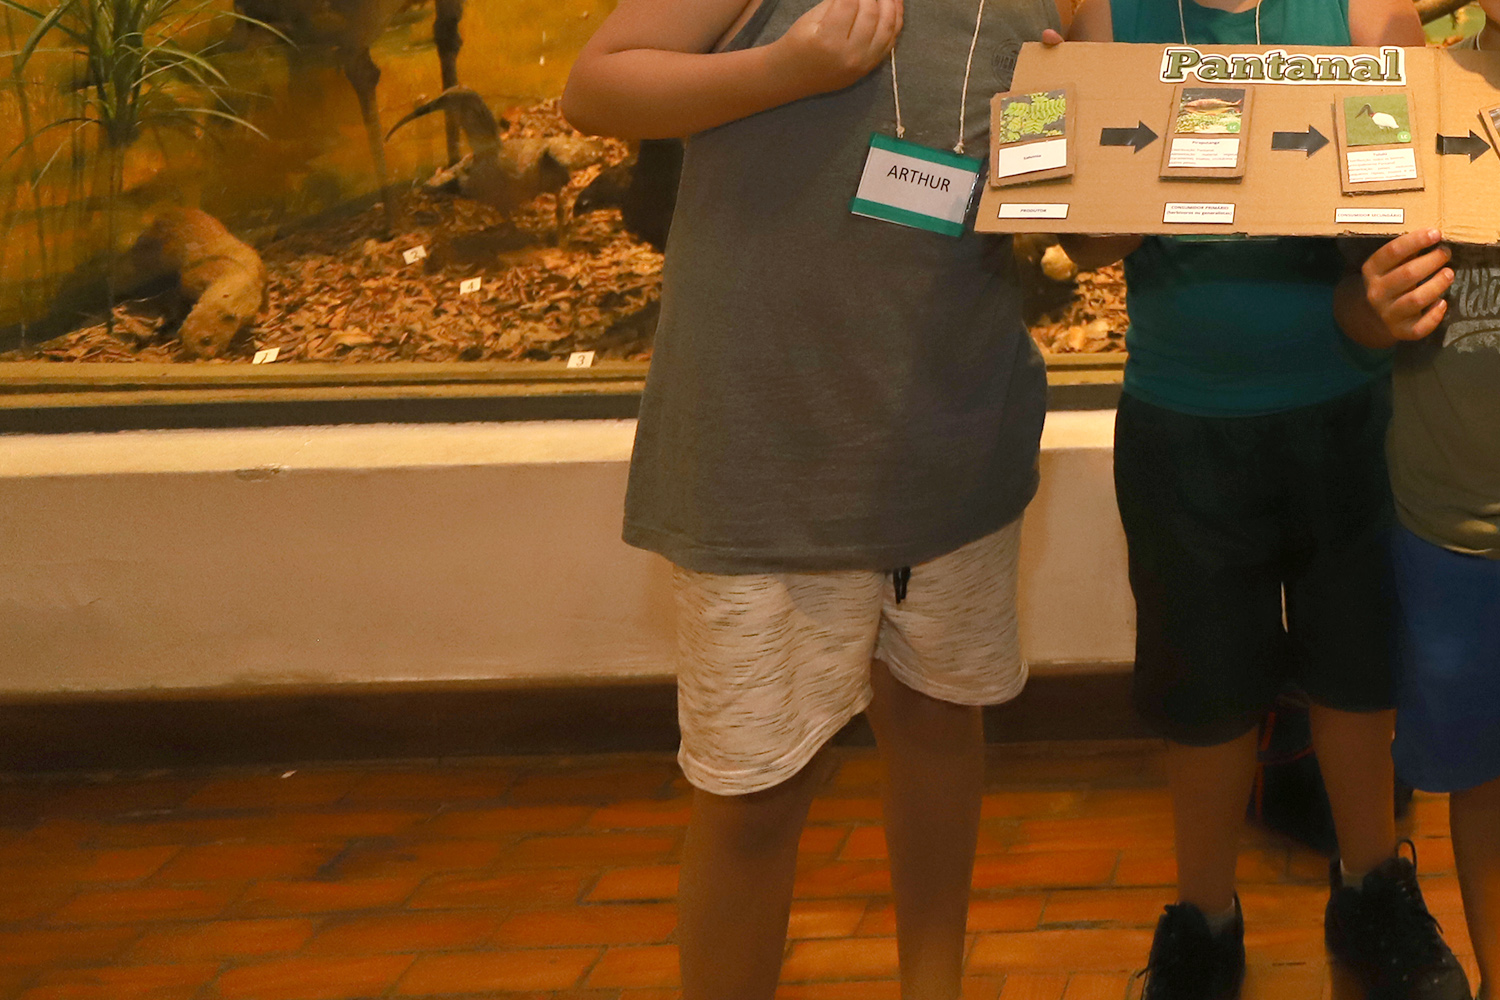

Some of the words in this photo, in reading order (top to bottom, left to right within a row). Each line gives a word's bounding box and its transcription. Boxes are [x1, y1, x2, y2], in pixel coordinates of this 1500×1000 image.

[1163, 48, 1402, 82] Pantanal
[886, 165, 951, 192] ARTHUR
[410, 251, 418, 260] 2
[576, 354, 586, 367] 3
